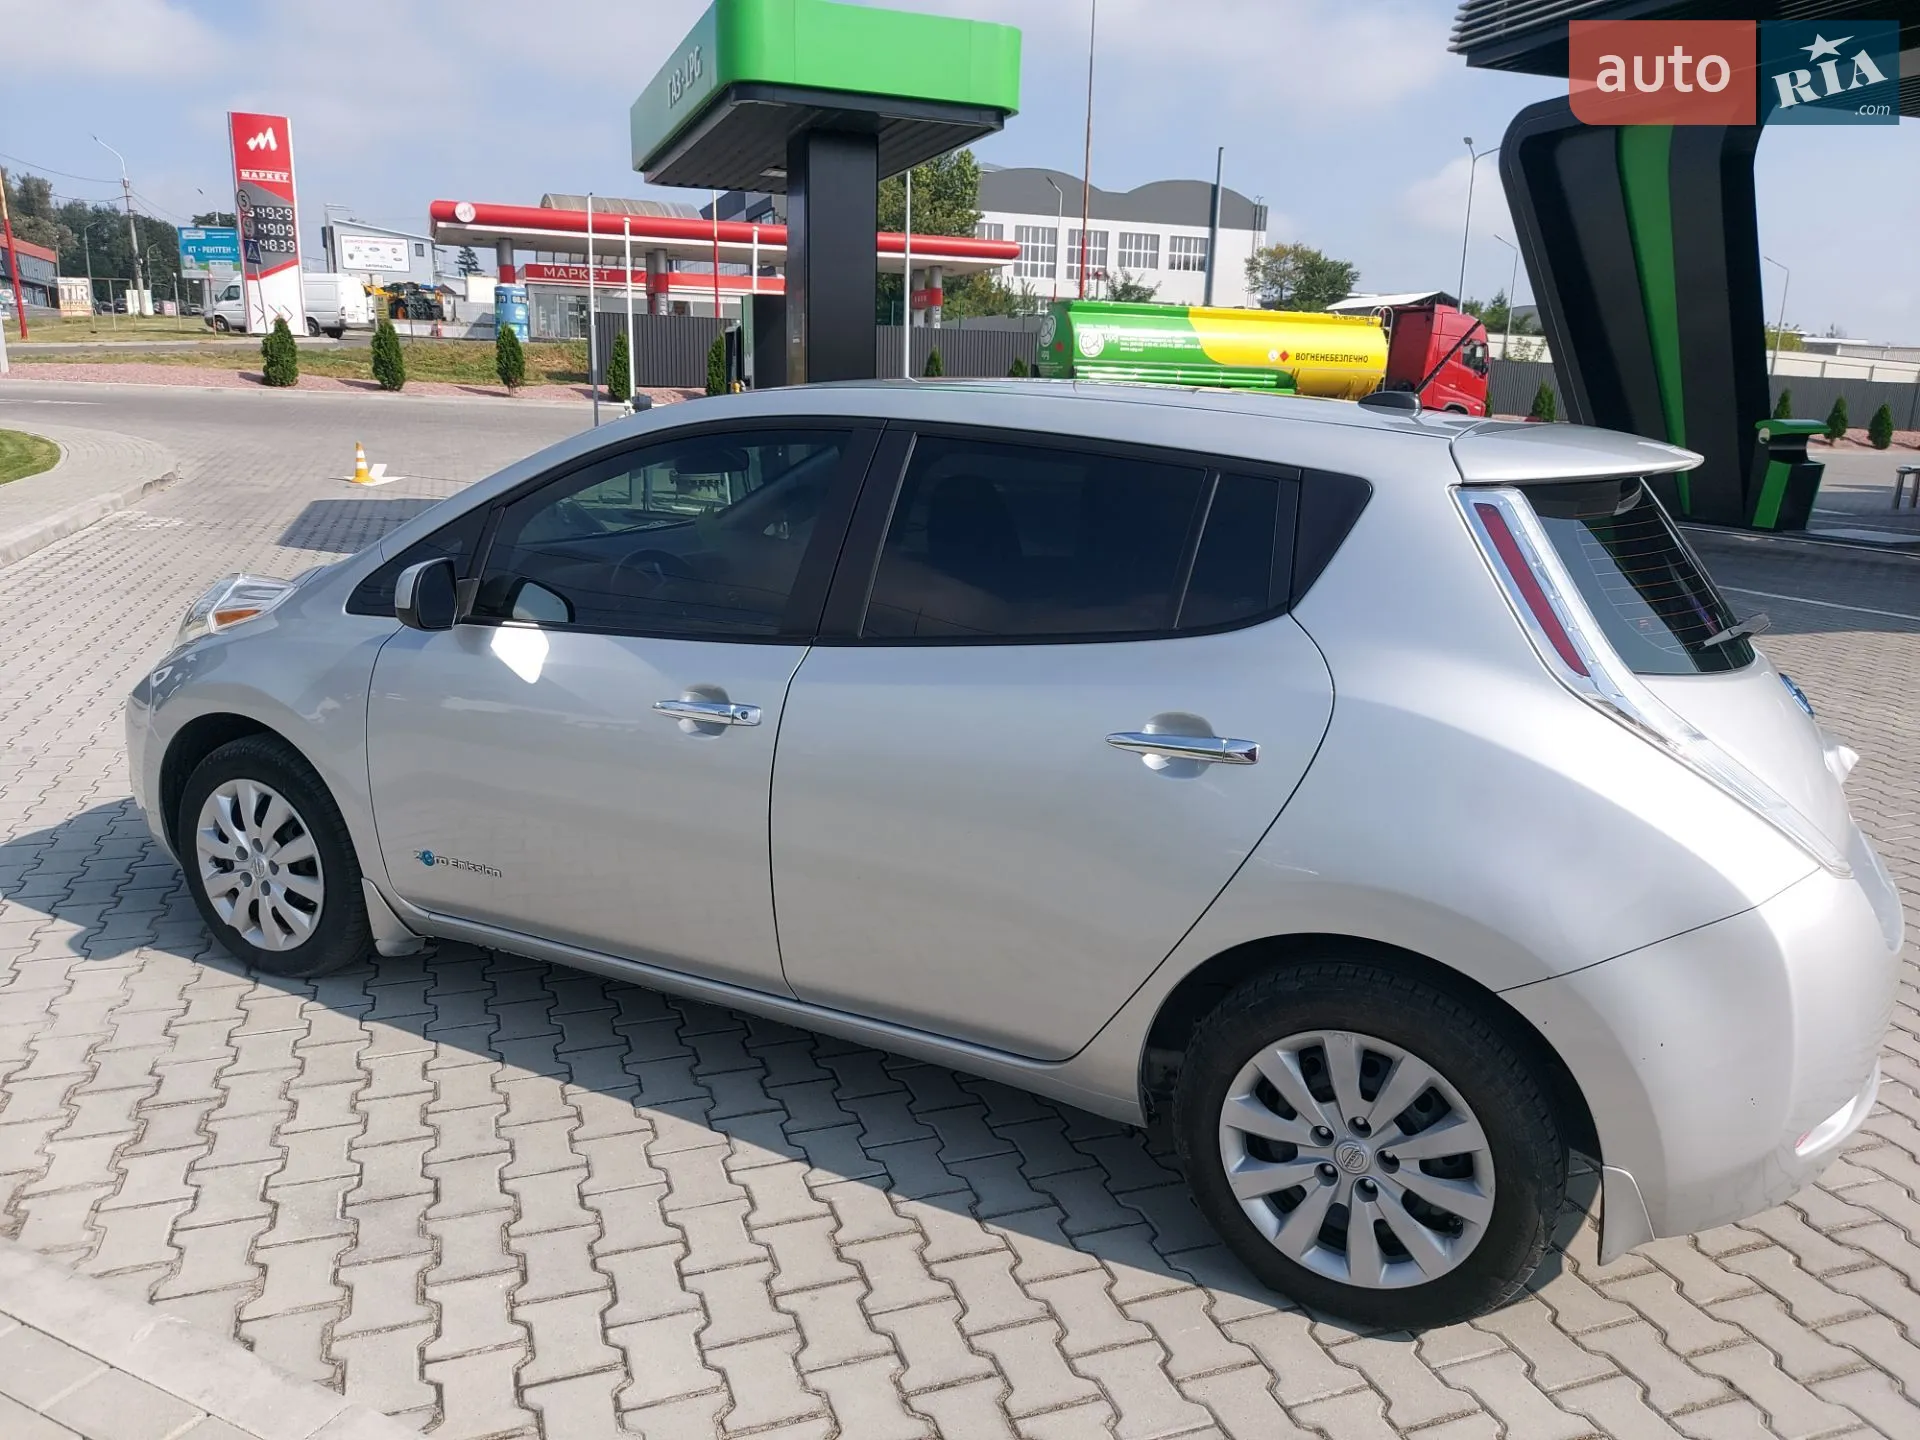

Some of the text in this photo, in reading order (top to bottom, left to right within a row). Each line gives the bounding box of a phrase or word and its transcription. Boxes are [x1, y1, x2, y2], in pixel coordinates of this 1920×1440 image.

[241, 171, 289, 181] МАРКЕТ
[543, 267, 610, 281] МАРКЕТ
[60, 285, 88, 301] TIR
[1295, 352, 1369, 364] ВОГНЕНЕБЕЗПЕЧНО
[449, 857, 502, 879] Emission
